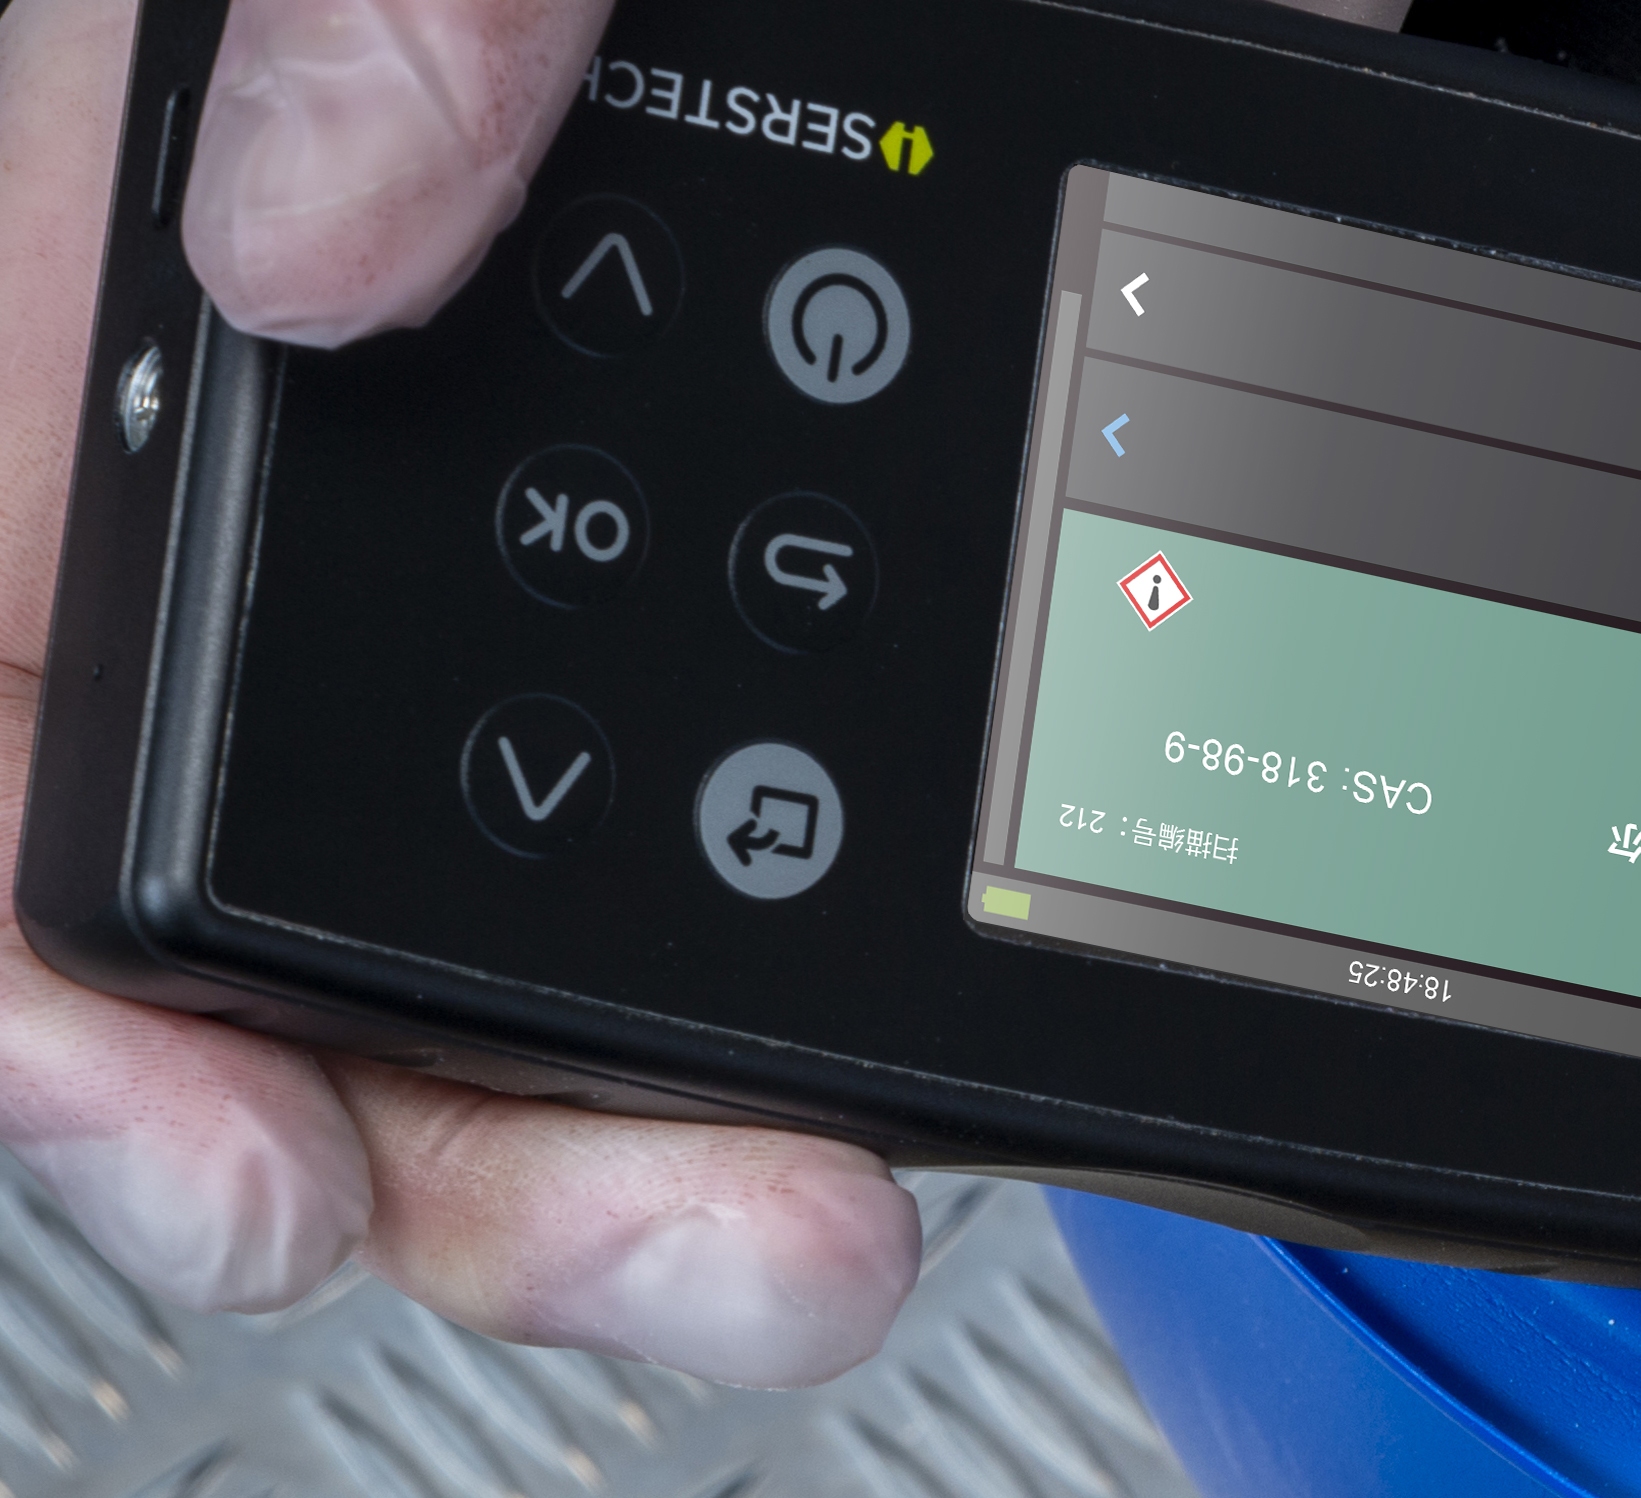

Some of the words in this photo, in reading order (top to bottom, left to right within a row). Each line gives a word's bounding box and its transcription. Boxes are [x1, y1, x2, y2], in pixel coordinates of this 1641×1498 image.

[519, 486, 630, 563] OK
[1163, 729, 1329, 795] 318-98-9
[1340, 766, 1433, 816] CAS:
[1347, 959, 1453, 1004] 18:48:25
